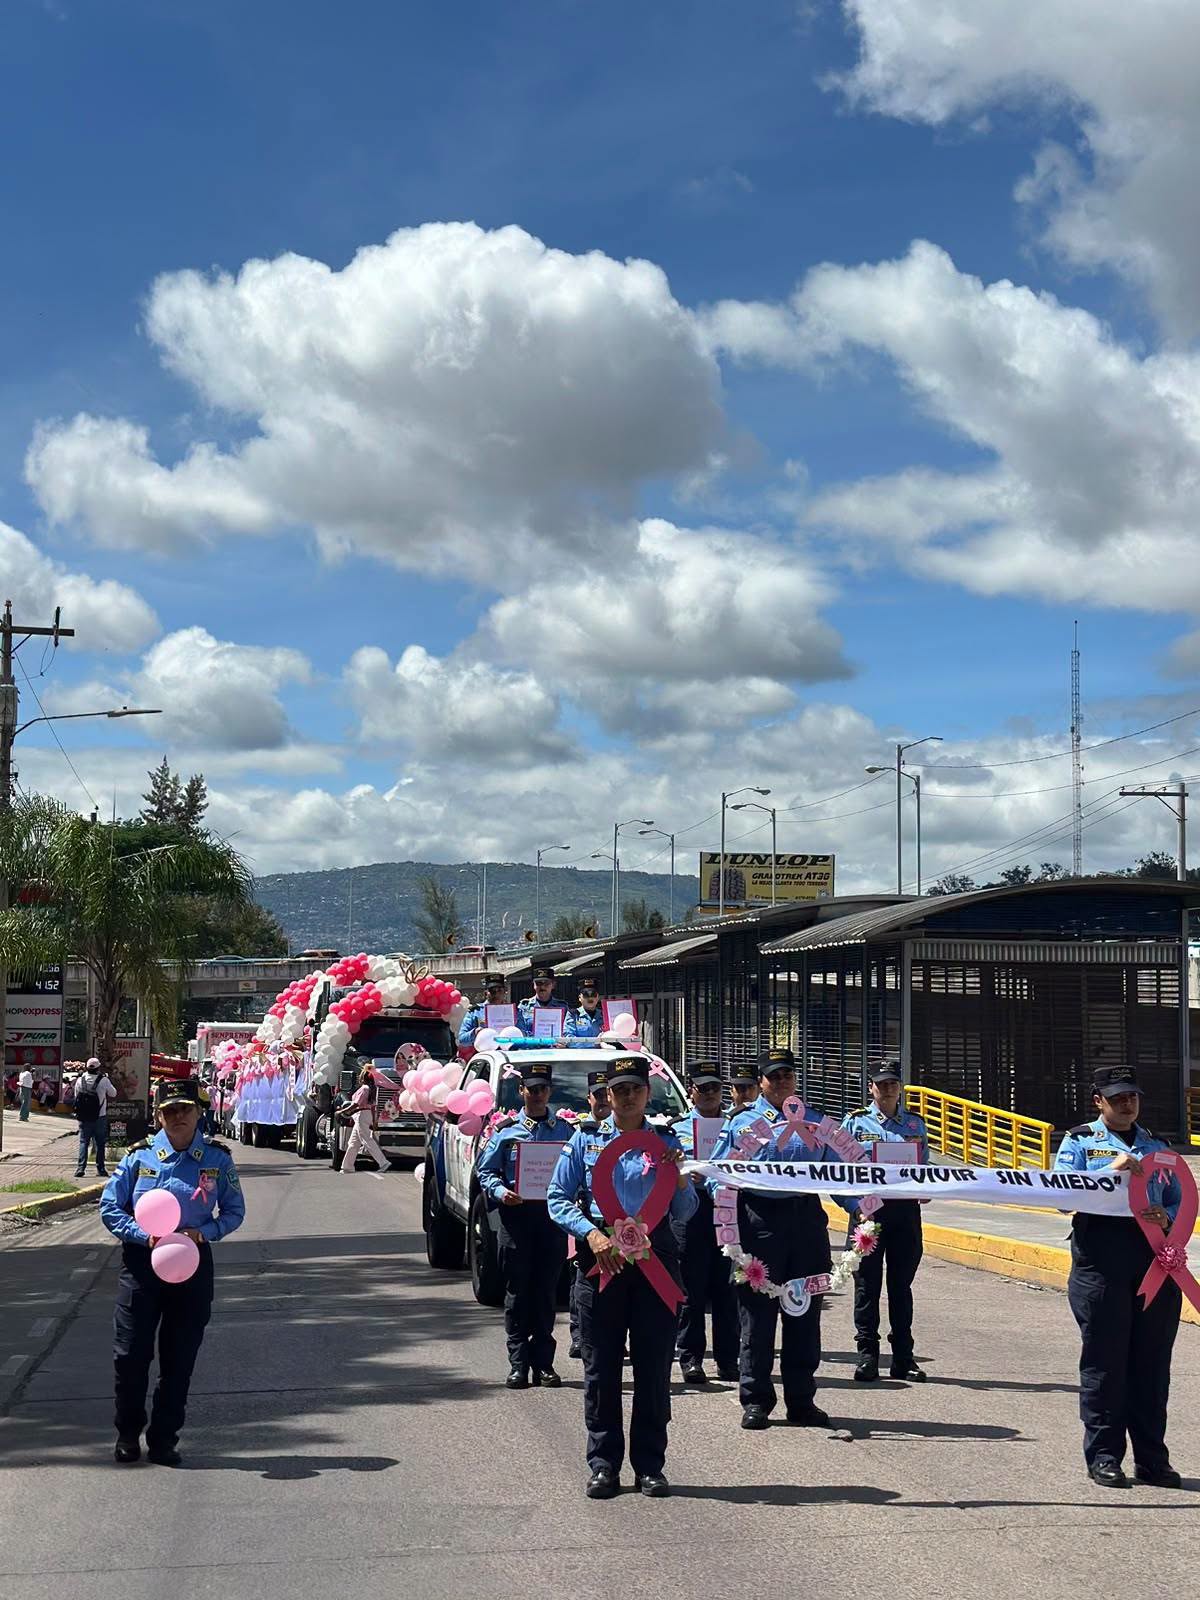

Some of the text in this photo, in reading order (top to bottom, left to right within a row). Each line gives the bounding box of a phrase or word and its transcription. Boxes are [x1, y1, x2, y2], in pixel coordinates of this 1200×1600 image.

[705, 853, 831, 866] DUNLOP
[5, 1008, 61, 1016] HOPexpress
[23, 1032, 57, 1040] PUMA
[996, 1170, 1033, 1186] SIN
